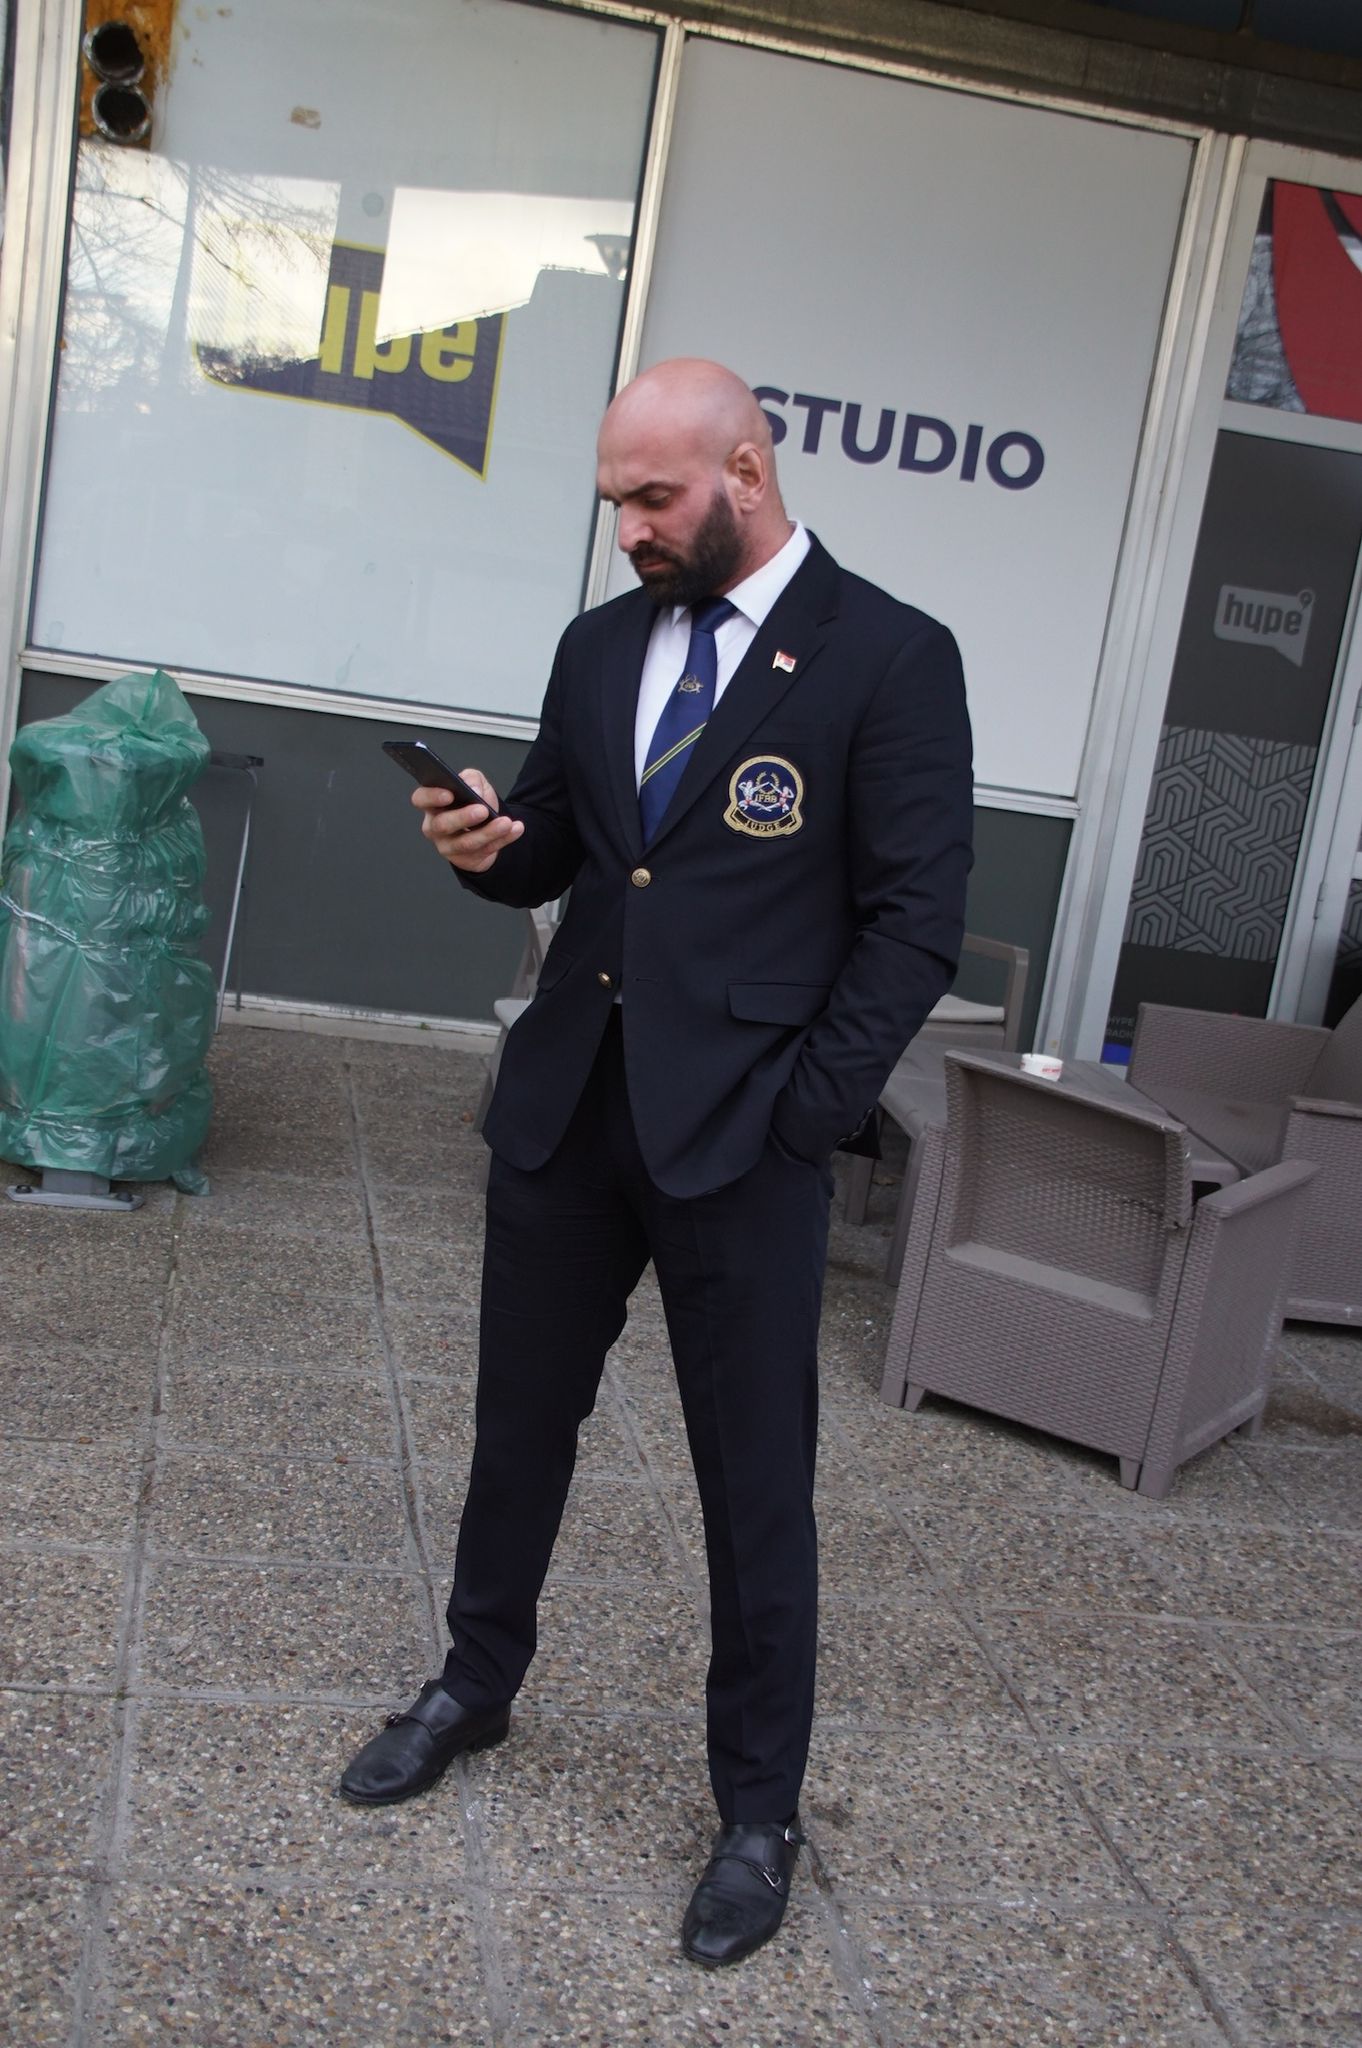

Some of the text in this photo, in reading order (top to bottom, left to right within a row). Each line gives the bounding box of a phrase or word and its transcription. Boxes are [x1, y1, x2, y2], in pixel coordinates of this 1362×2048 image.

[751, 386, 1044, 490] STUDIO
[1222, 592, 1302, 636] hype
[755, 793, 777, 803] IFBB
[744, 820, 779, 831] JUDGE
